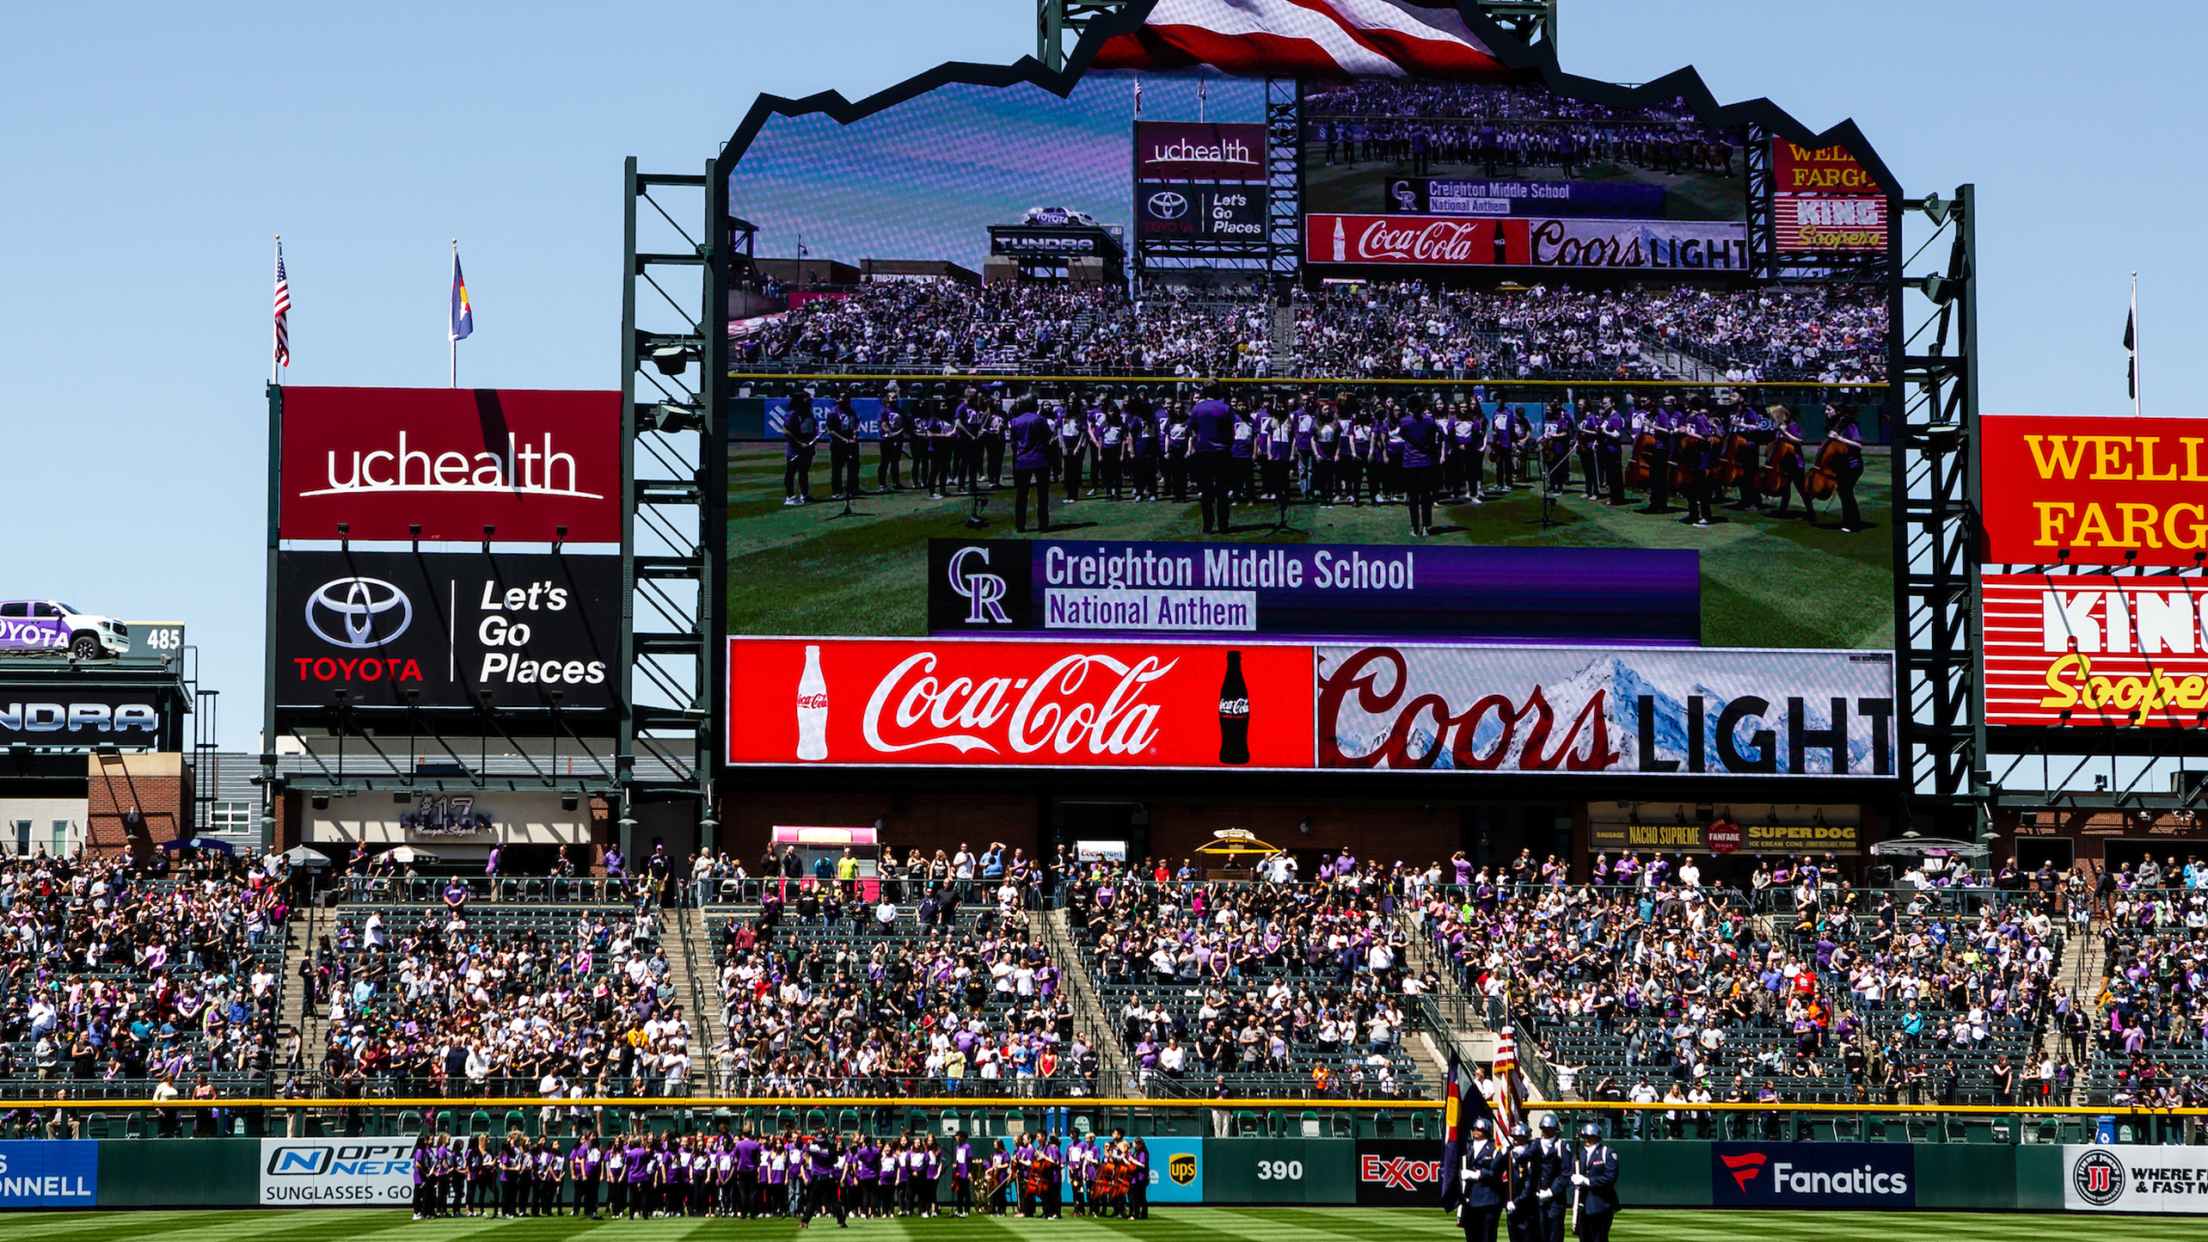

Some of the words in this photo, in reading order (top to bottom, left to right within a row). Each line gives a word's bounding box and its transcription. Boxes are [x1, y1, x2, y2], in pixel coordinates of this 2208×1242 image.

[1154, 138, 1250, 162] uchealth
[1213, 193, 1246, 206] Let's
[1429, 182, 1486, 199] Creighton
[1489, 183, 1527, 198] Middle
[1531, 184, 1570, 199] School
[1212, 207, 1233, 220] Go
[1430, 199, 1470, 212] National
[1472, 200, 1507, 212] Anthem
[1796, 201, 1880, 226] KING
[1213, 220, 1262, 234] Places
[1797, 225, 1880, 249] Soopers
[996, 237, 1094, 251] TUNDRA
[1358, 220, 1478, 261] Coca-Cola
[1530, 220, 1646, 268] Coors
[1650, 239, 1748, 269] LIGHT
[328, 430, 576, 493] uchealth
[1046, 546, 1192, 590] Creighton
[1204, 548, 1303, 589] Middle
[1314, 550, 1414, 590] School
[480, 580, 568, 611] Let's
[1050, 594, 1148, 624] National
[1157, 596, 1248, 626] Anthem
[147, 628, 180, 650] 485
[478, 615, 531, 647] Go
[294, 657, 424, 682] TOYOTA
[479, 652, 606, 684] Places
[2040, 653, 2208, 725] Soope
[863, 652, 1180, 756] Coca-Cola
[1318, 646, 1620, 772] Coors
[1638, 695, 1895, 775] LIGHT
[1629, 826, 1658, 845] NACHO
[1660, 826, 1700, 845] SUPREME
[1708, 832, 1740, 842] FANFARE
[1748, 826, 1813, 839] SUPER
[1814, 826, 1856, 840] DOG
[1171, 1163, 1195, 1182] ups
[1256, 1160, 1304, 1181] 390
[1774, 1162, 1908, 1194] Fanatics
[2131, 1168, 2192, 1180] WHERE
[266, 1186, 374, 1200] SUNGLASSES
[2136, 1182, 2148, 1194] &
[2152, 1182, 2194, 1194] FAST
